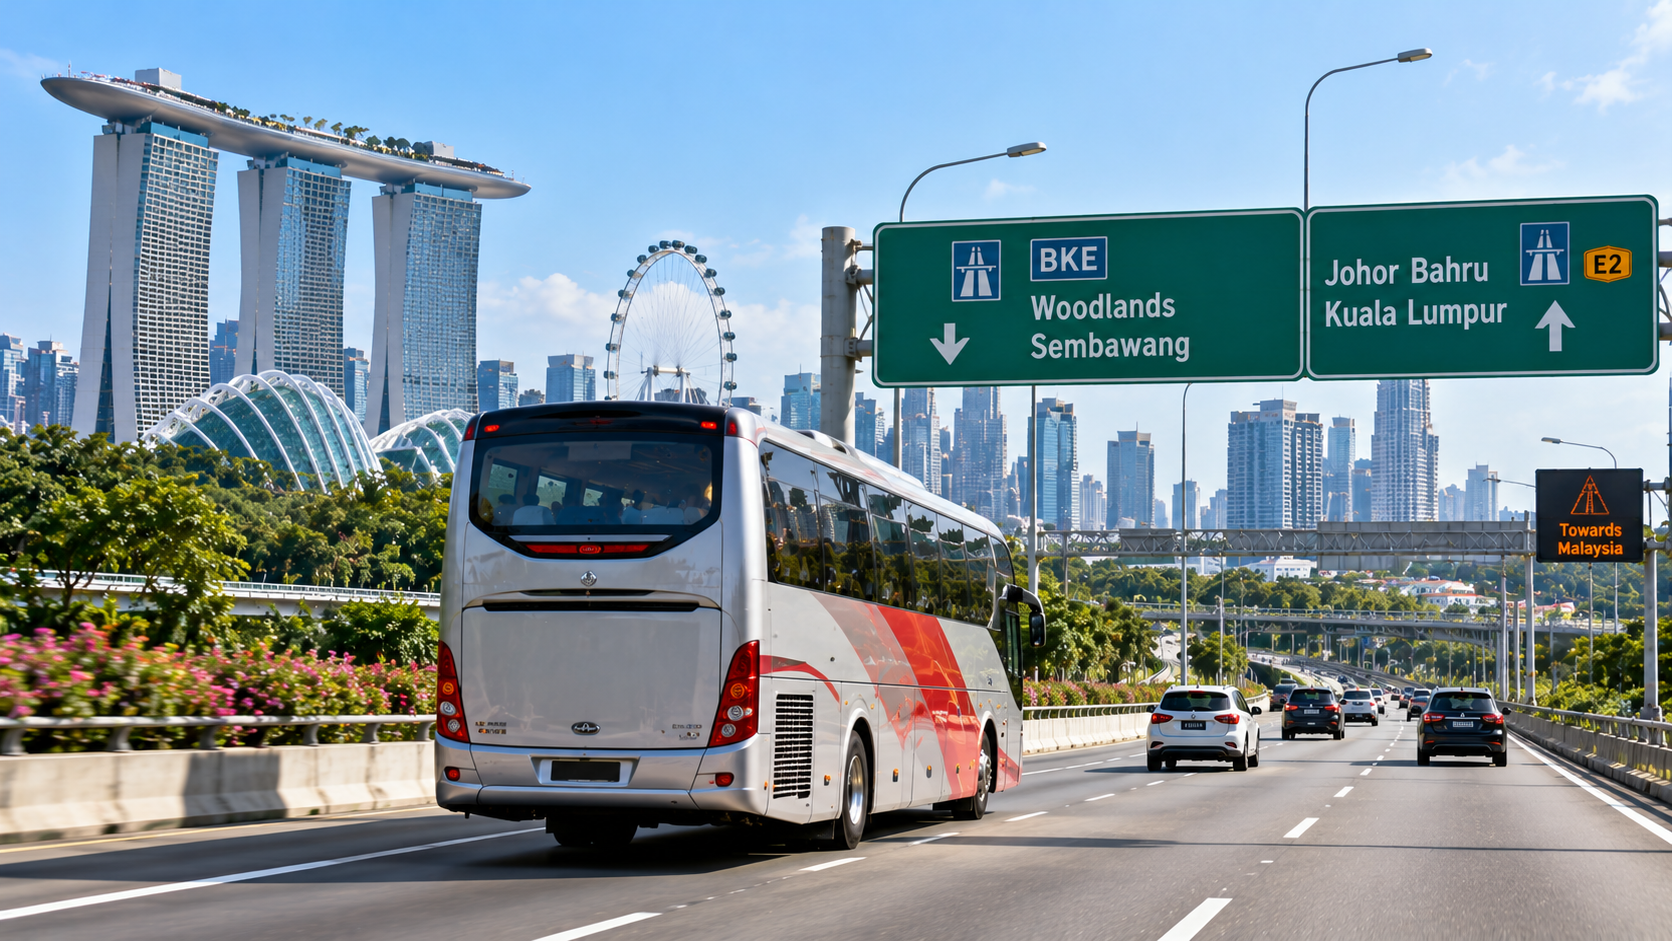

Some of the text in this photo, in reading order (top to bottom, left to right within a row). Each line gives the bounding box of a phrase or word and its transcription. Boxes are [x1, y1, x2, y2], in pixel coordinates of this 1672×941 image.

[1040, 246, 1097, 272] BKE
[1325, 255, 1488, 286] Johor Bahru
[1593, 253, 1622, 275] E2
[1030, 291, 1176, 320] Woodlands
[1325, 298, 1507, 330] Kuala Lumpur
[1030, 332, 1190, 363] Sembawang
[1559, 523, 1622, 537] Towards
[1558, 541, 1624, 558] Malaysia
